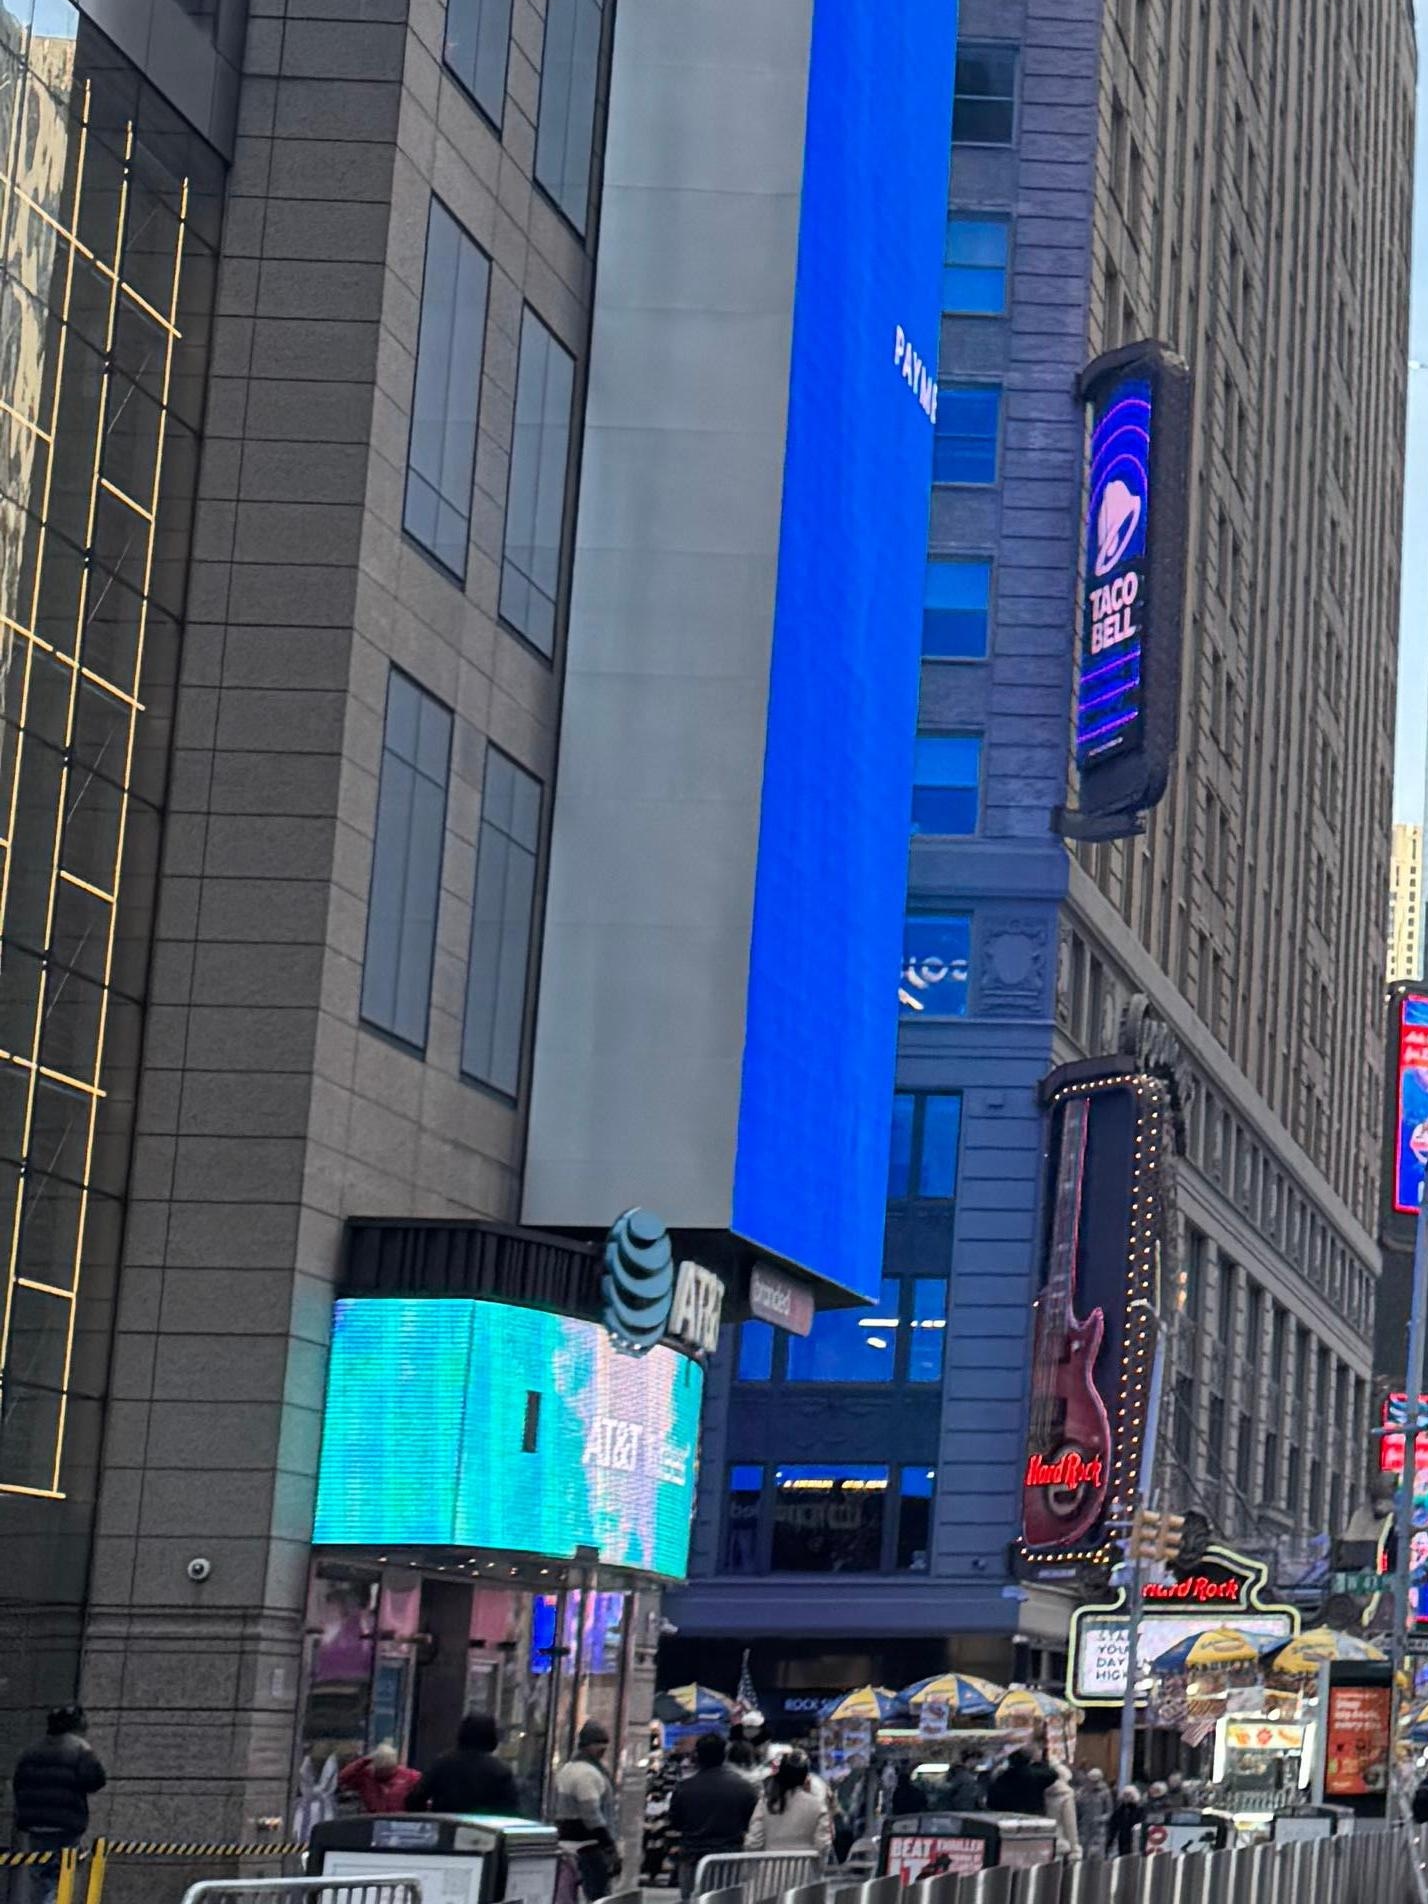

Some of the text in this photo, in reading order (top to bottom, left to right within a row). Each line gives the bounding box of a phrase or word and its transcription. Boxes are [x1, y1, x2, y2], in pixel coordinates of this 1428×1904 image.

[1089, 571, 1139, 622] TACO
[1091, 606, 1137, 656] BELL
[1026, 1451, 1103, 1491] Hard Rock
[1193, 1576, 1240, 1602] Rock
[1096, 1658, 1126, 1668] DAY
[893, 1837, 934, 1858] BEAT
